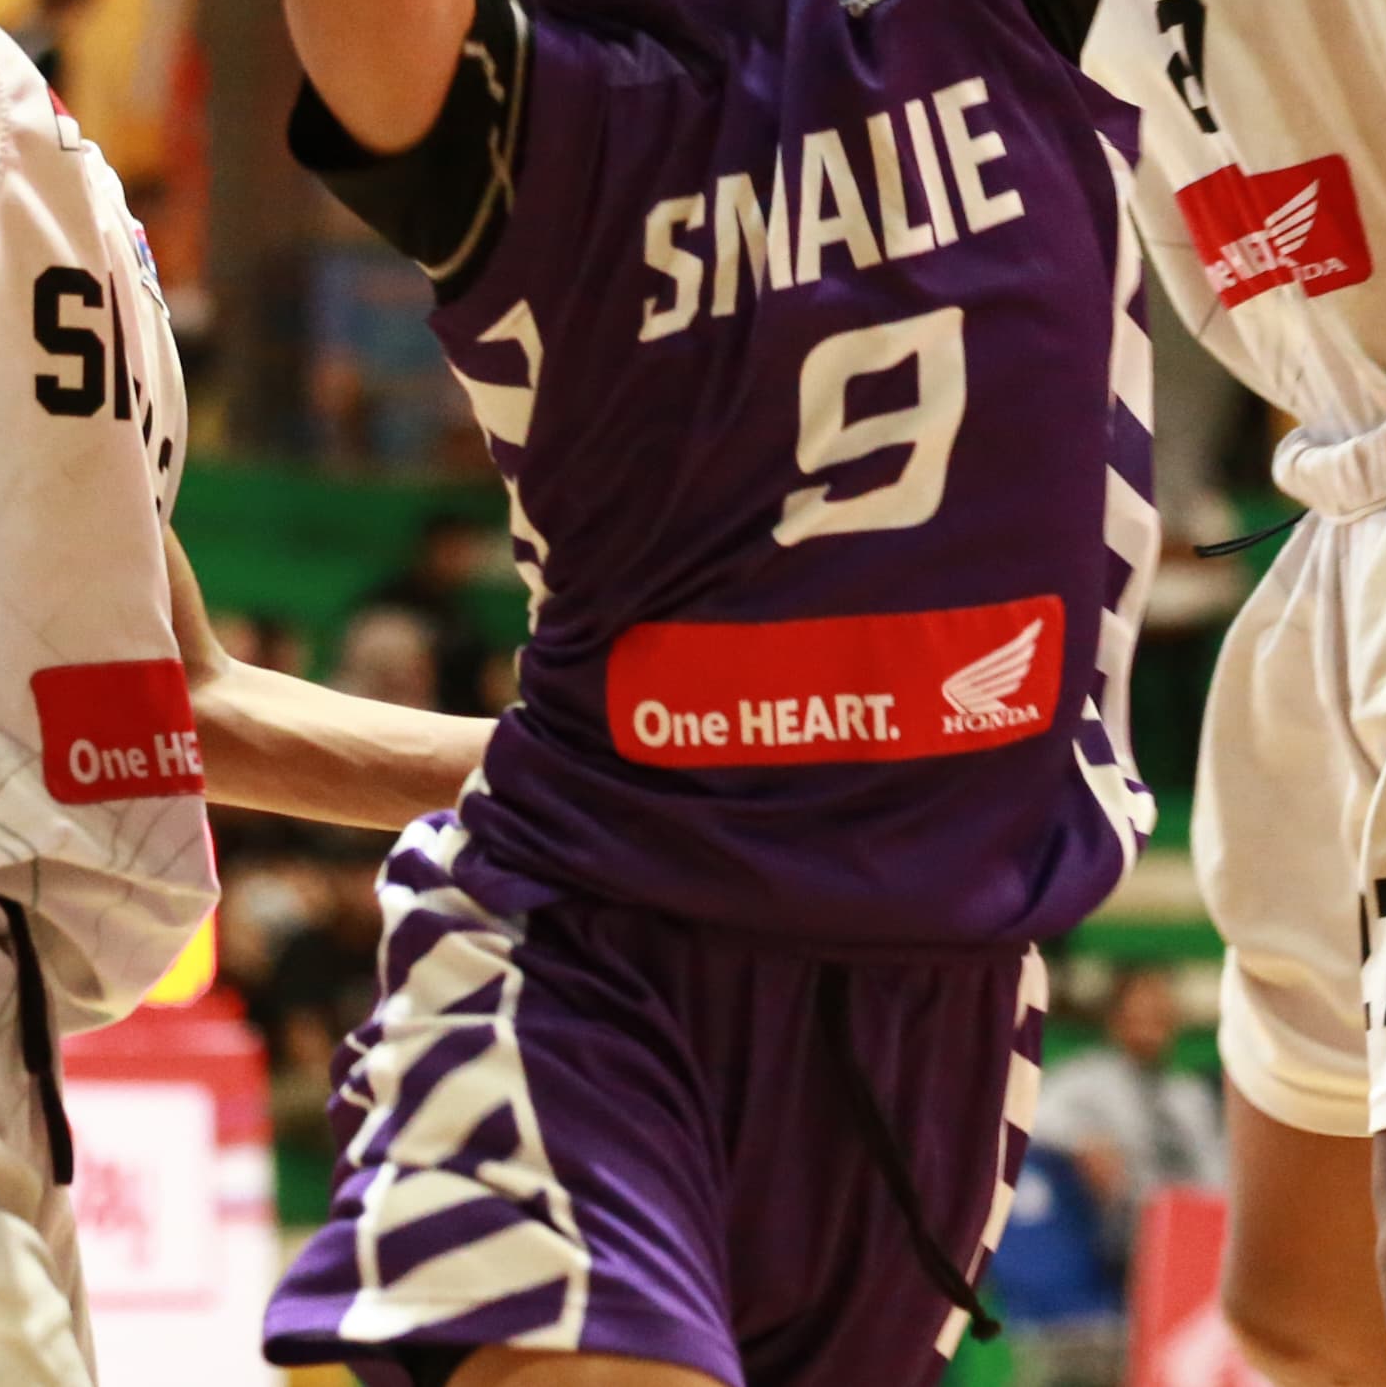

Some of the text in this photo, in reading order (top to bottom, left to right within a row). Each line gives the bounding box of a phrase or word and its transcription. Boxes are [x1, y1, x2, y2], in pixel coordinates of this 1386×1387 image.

[638, 76, 1026, 343] SMALIE
[771, 305, 967, 547] 9
[632, 693, 901, 748] One HEART.
[940, 703, 1040, 735] HONDA
[69, 738, 149, 785] One
